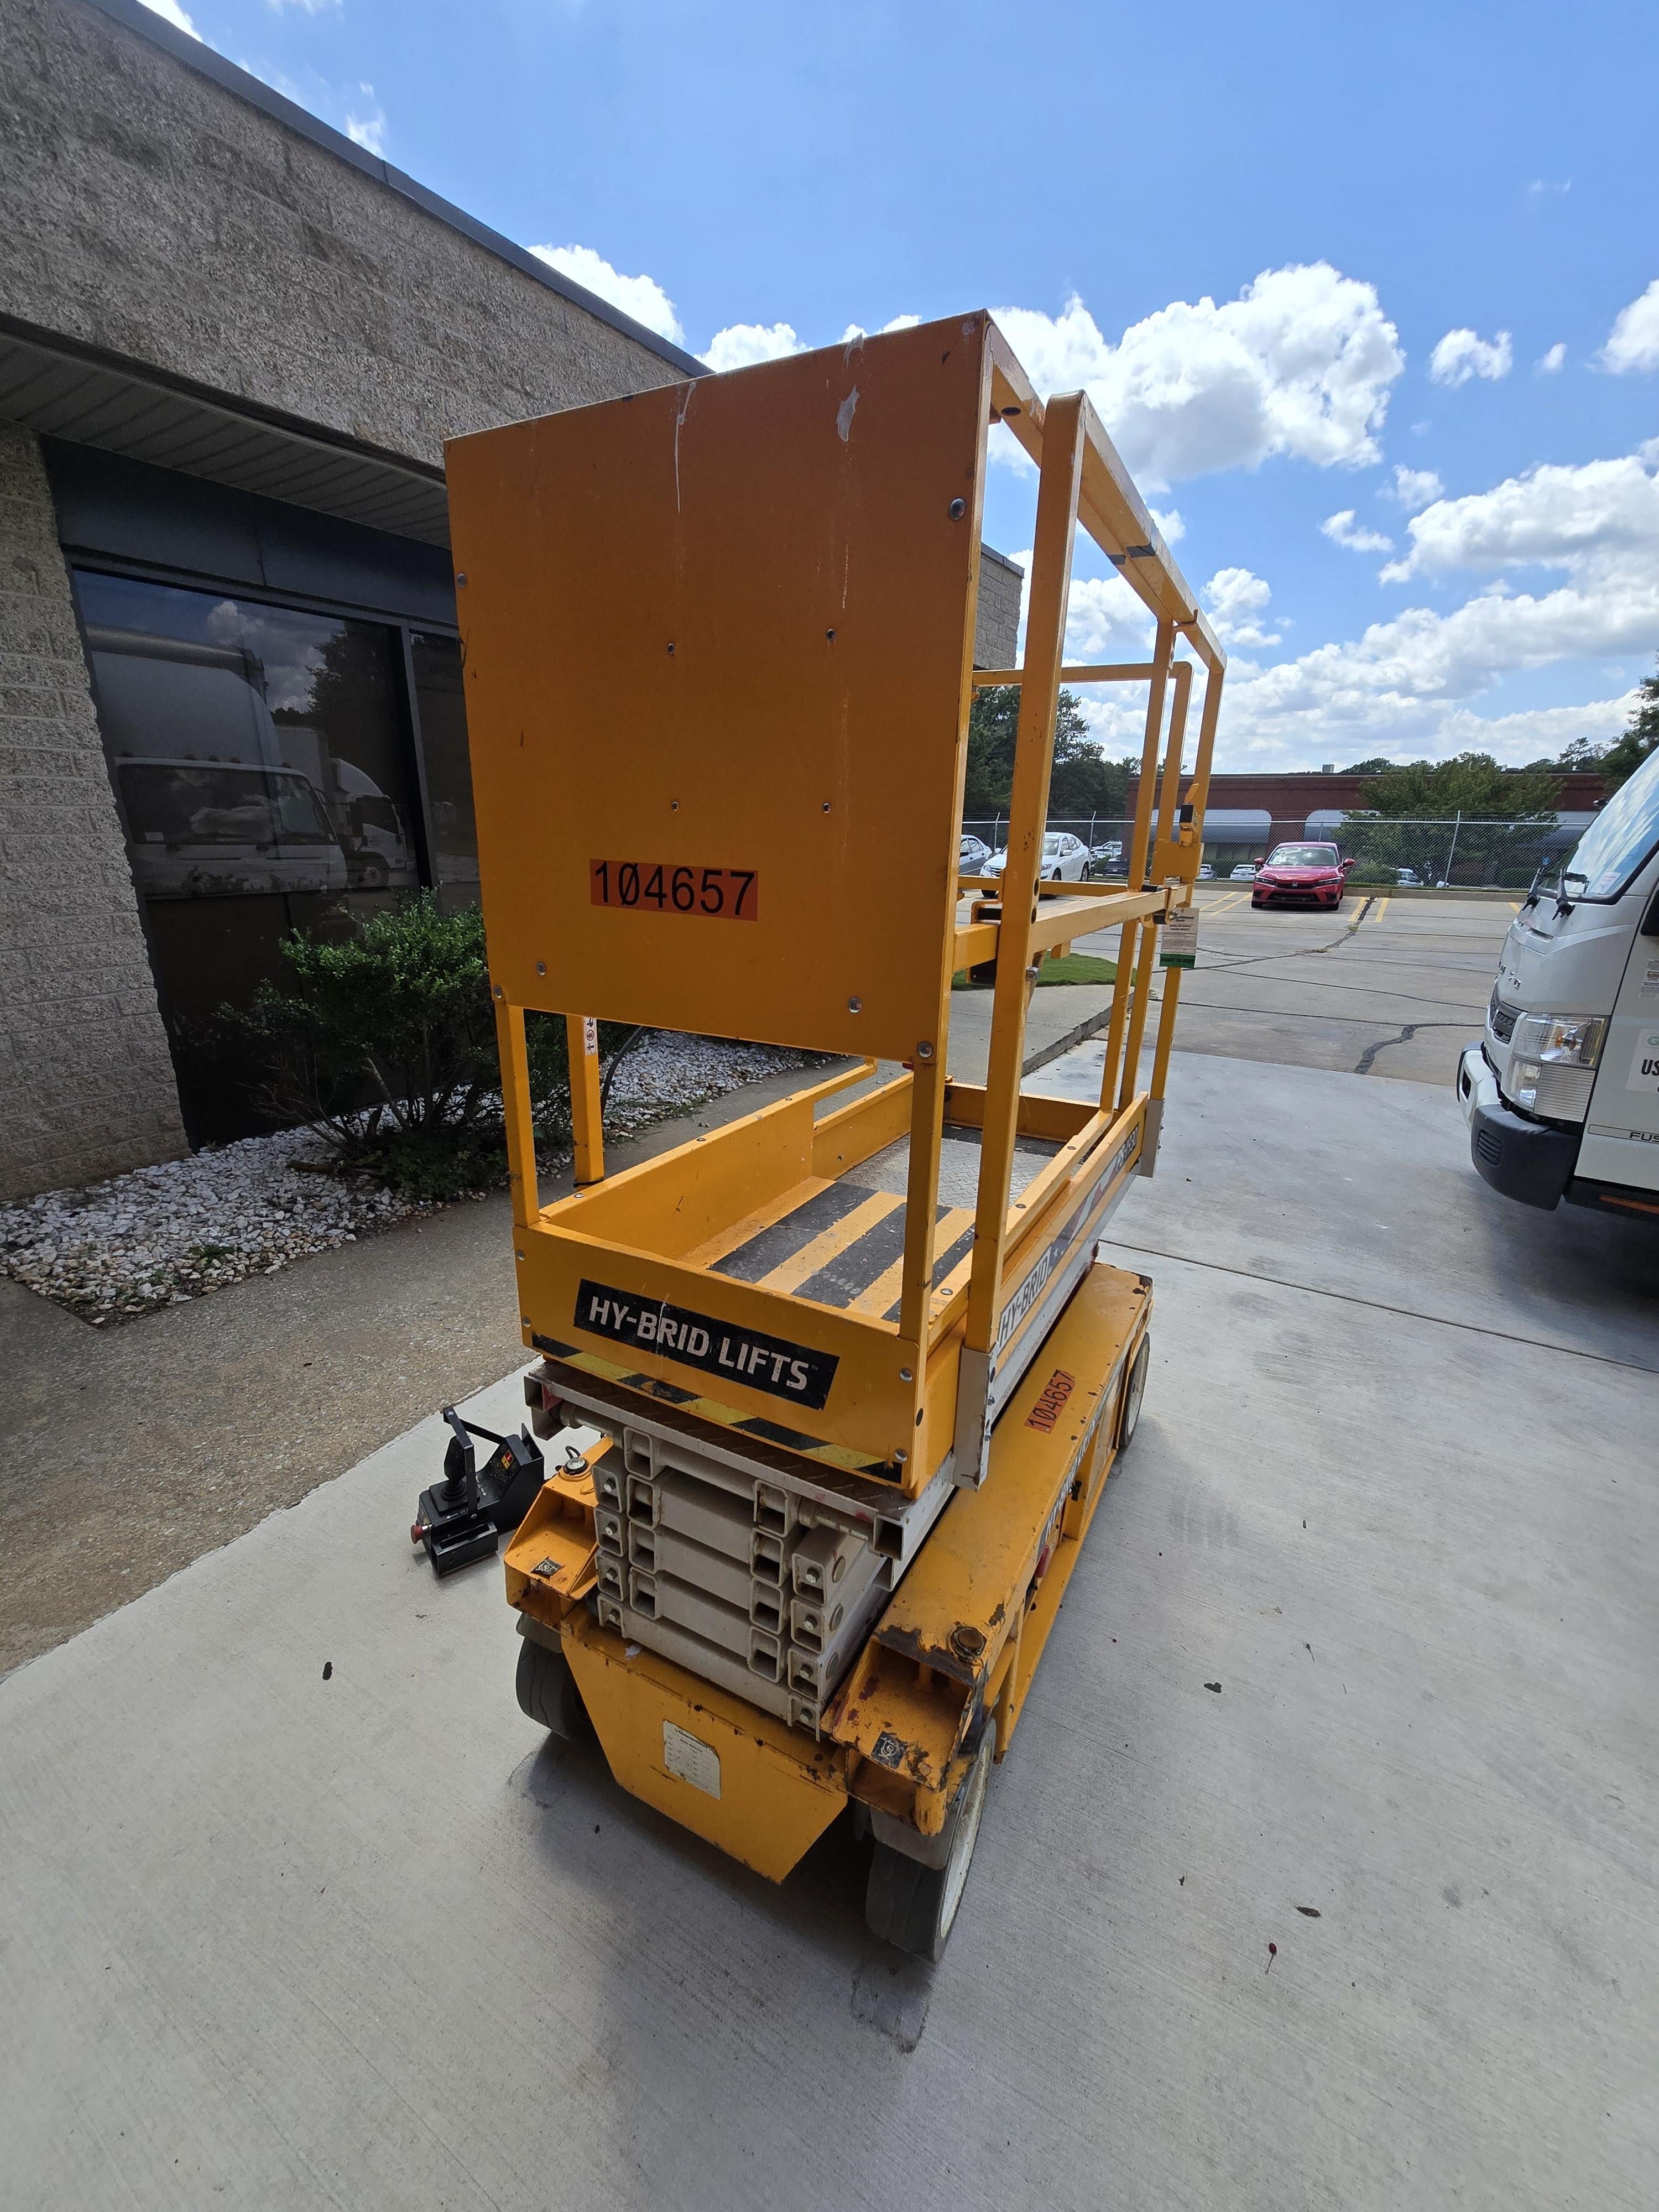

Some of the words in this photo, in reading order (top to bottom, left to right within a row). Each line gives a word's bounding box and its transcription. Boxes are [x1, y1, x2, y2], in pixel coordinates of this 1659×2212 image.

[595, 861, 755, 916] 104657
[999, 1255, 1048, 1348] HY-BRID
[589, 1296, 709, 1357] HY-BRID
[718, 1336, 809, 1390] LIFTS
[1027, 1369, 1074, 1428] 104657
